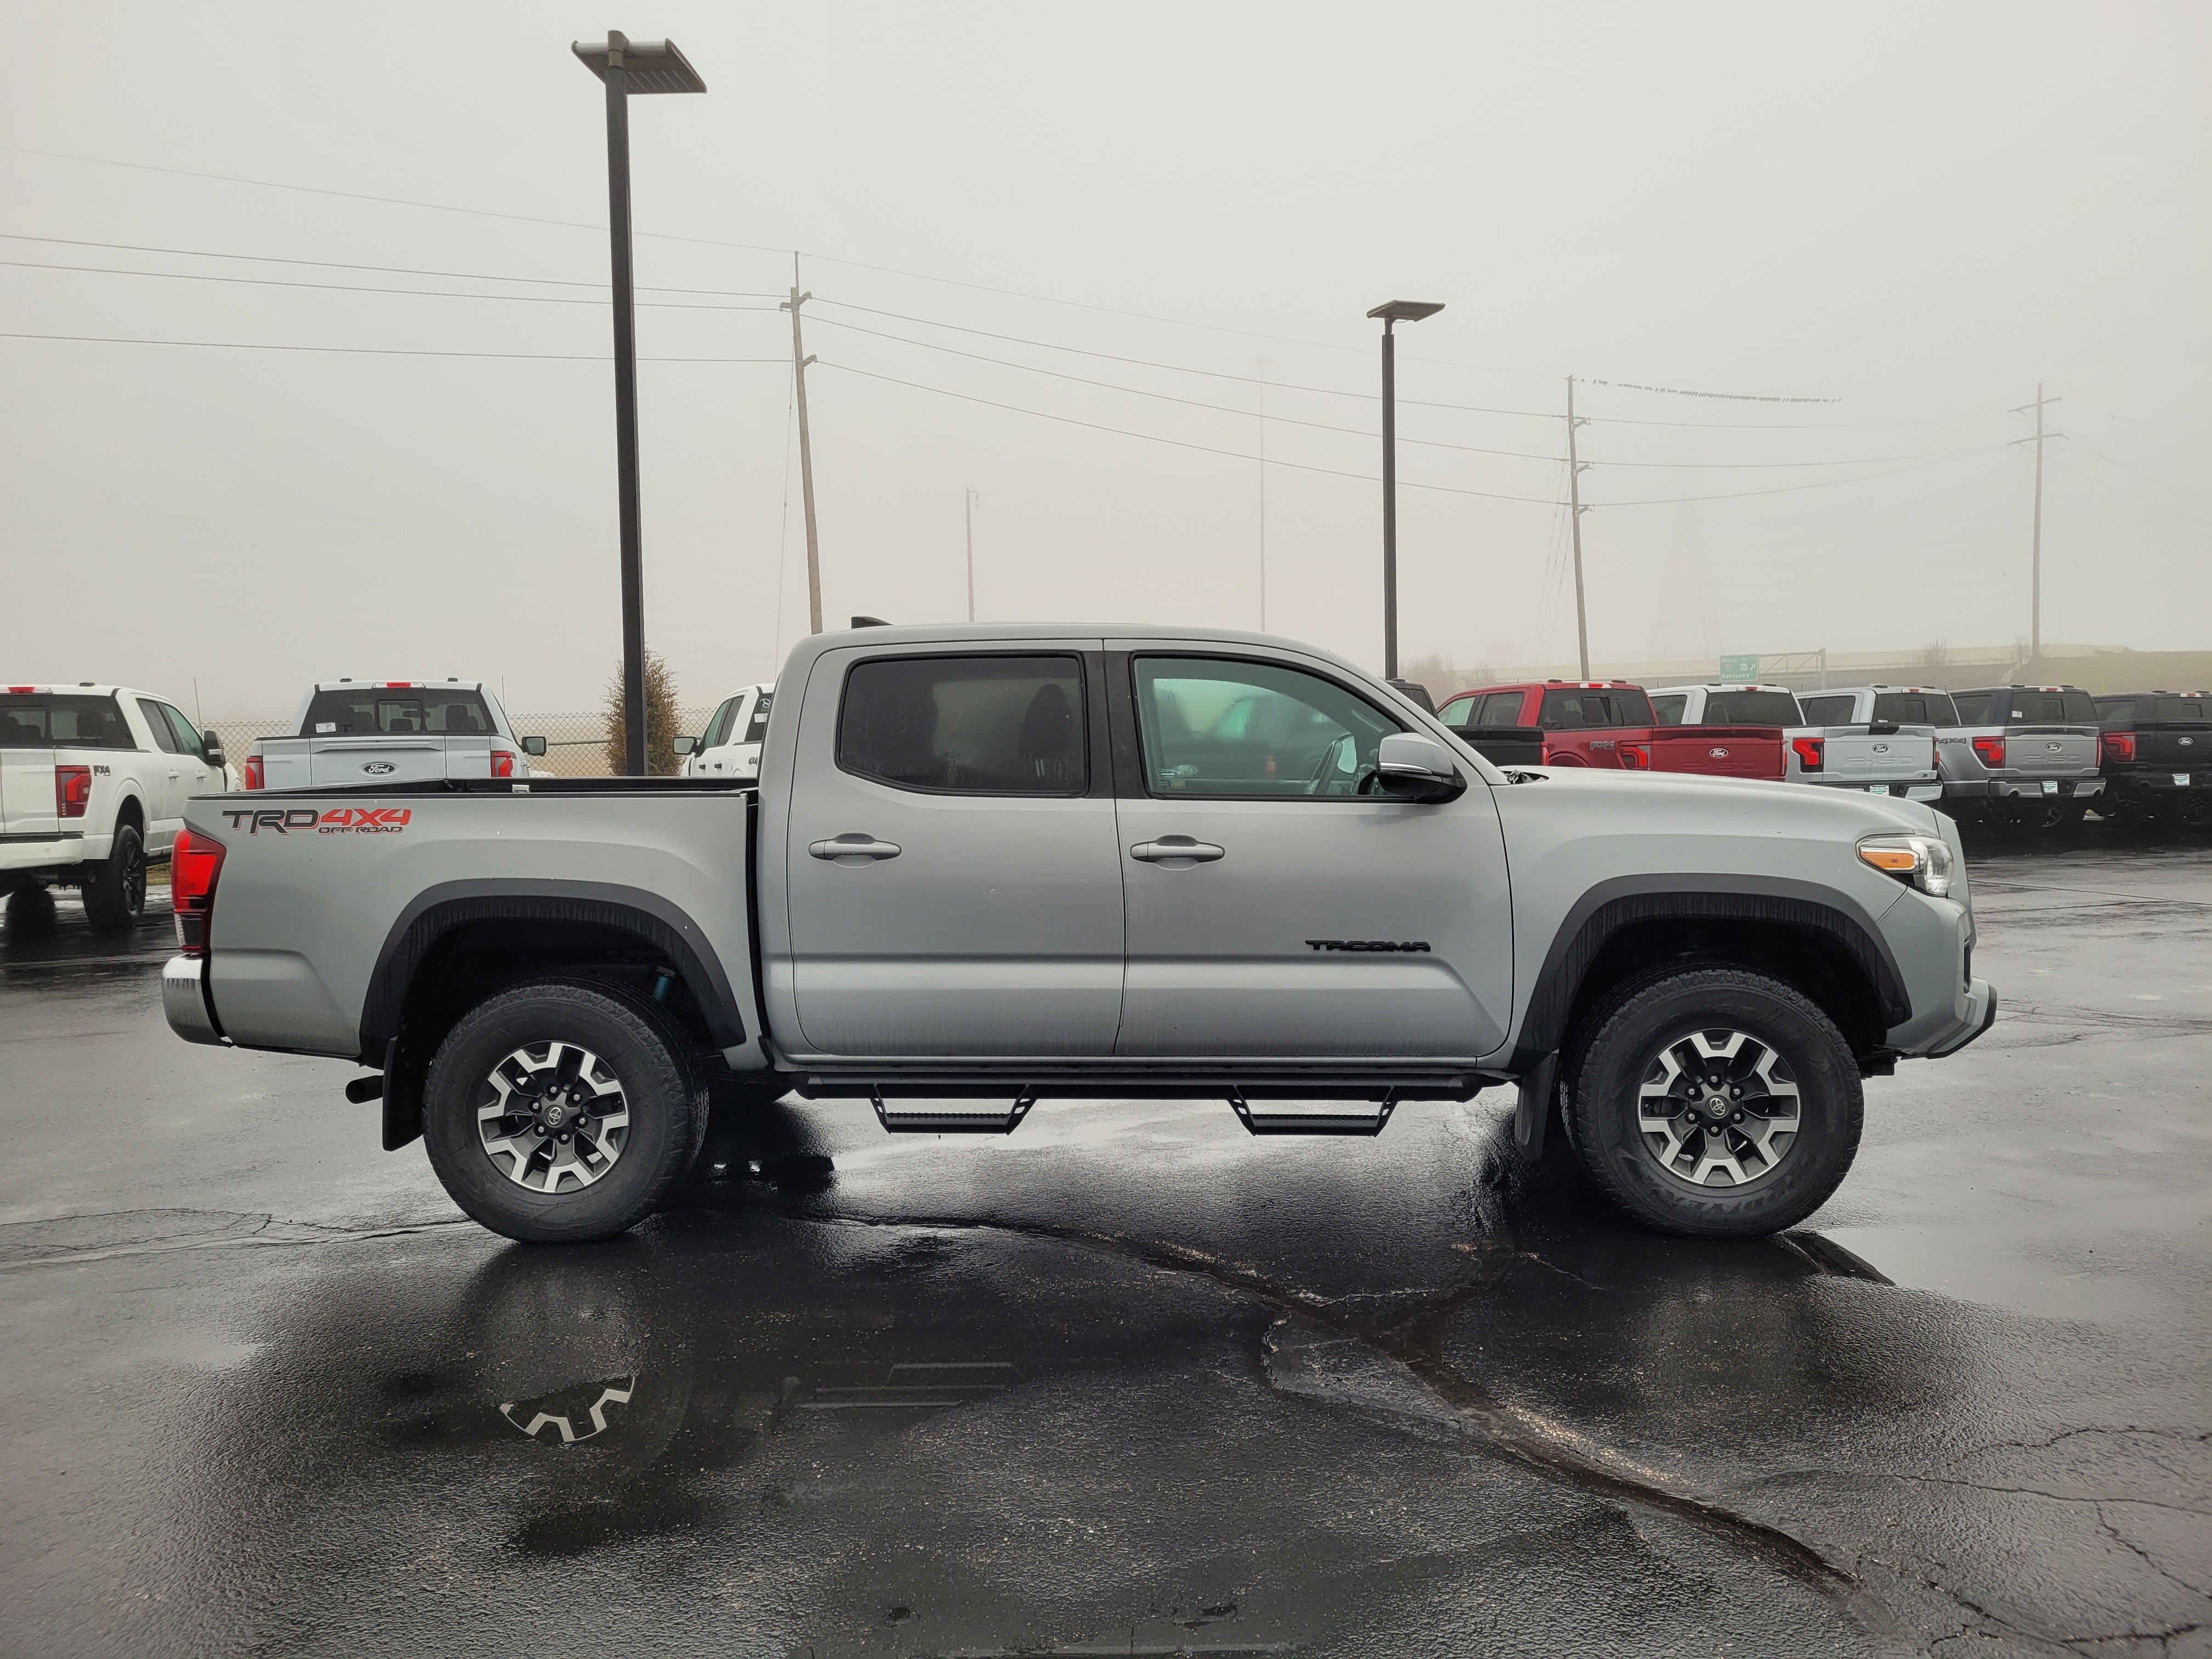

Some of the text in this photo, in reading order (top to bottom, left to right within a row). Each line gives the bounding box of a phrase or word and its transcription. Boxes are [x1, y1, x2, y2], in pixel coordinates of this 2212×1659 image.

[1590, 741, 1615, 750] FX4
[93, 765, 111, 776] FX4
[368, 764, 390, 774] Ford
[222, 809, 321, 836] TRD
[318, 826, 404, 834] OFF ROAD
[1305, 940, 1431, 952] TACOMA
